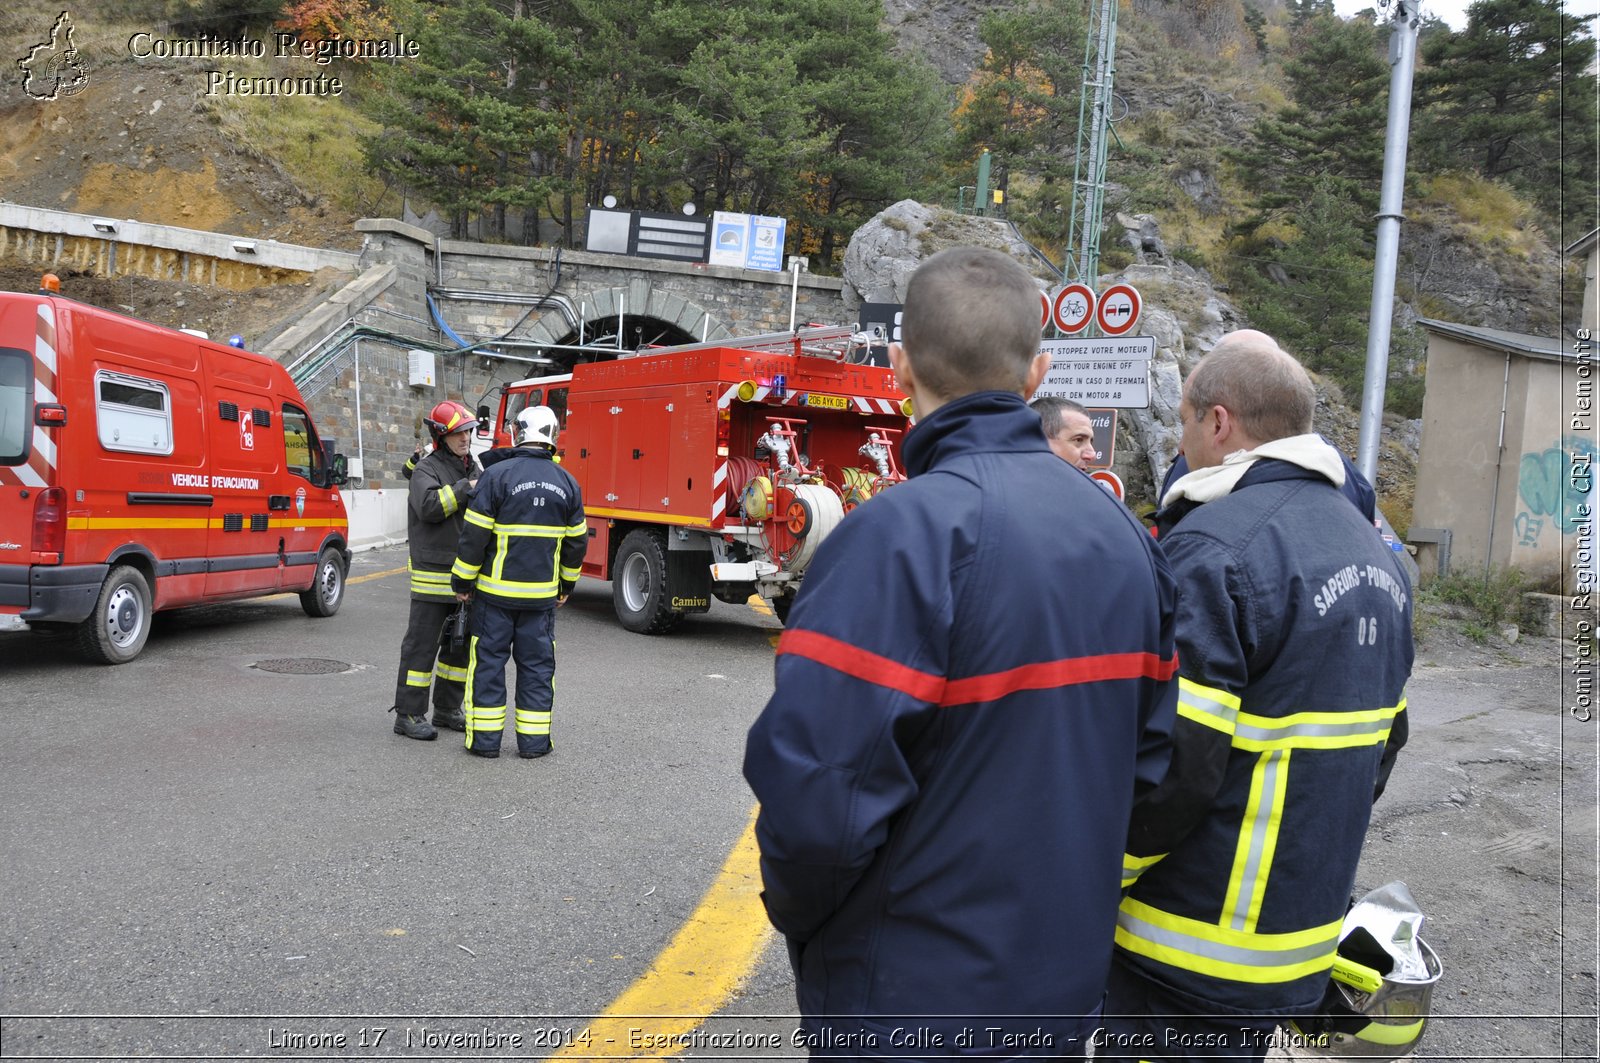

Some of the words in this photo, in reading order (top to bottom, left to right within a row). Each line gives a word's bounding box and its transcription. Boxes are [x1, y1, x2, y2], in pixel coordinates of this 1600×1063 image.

[1036, 347, 1054, 355] RRET
[1057, 347, 1088, 355] STOPPEZ
[1091, 346, 1114, 354] VOTRE
[1117, 345, 1148, 354] MOTEUR
[1048, 362, 1071, 370] SWITCH
[1074, 362, 1090, 370] YOUR
[1093, 362, 1117, 370] ENGINE
[1119, 361, 1133, 370] OFF
[1048, 377, 1073, 385] MOTORE
[1076, 377, 1083, 385] IN
[1085, 377, 1103, 385] CASO
[1105, 377, 1113, 385] DI
[1115, 377, 1146, 385] FERMATA
[1069, 391, 1083, 399] DEN
[1086, 391, 1110, 399] MOTOR
[1112, 391, 1122, 399] AB
[808, 395, 821, 405] 206
[822, 396, 834, 406] AYK
[835, 397, 844, 408] 06
[243, 432, 253, 447] 18
[171, 473, 209, 488] VEHICULE
[211, 476, 259, 490] D'EVACUATION
[671, 596, 707, 607] Camiva
